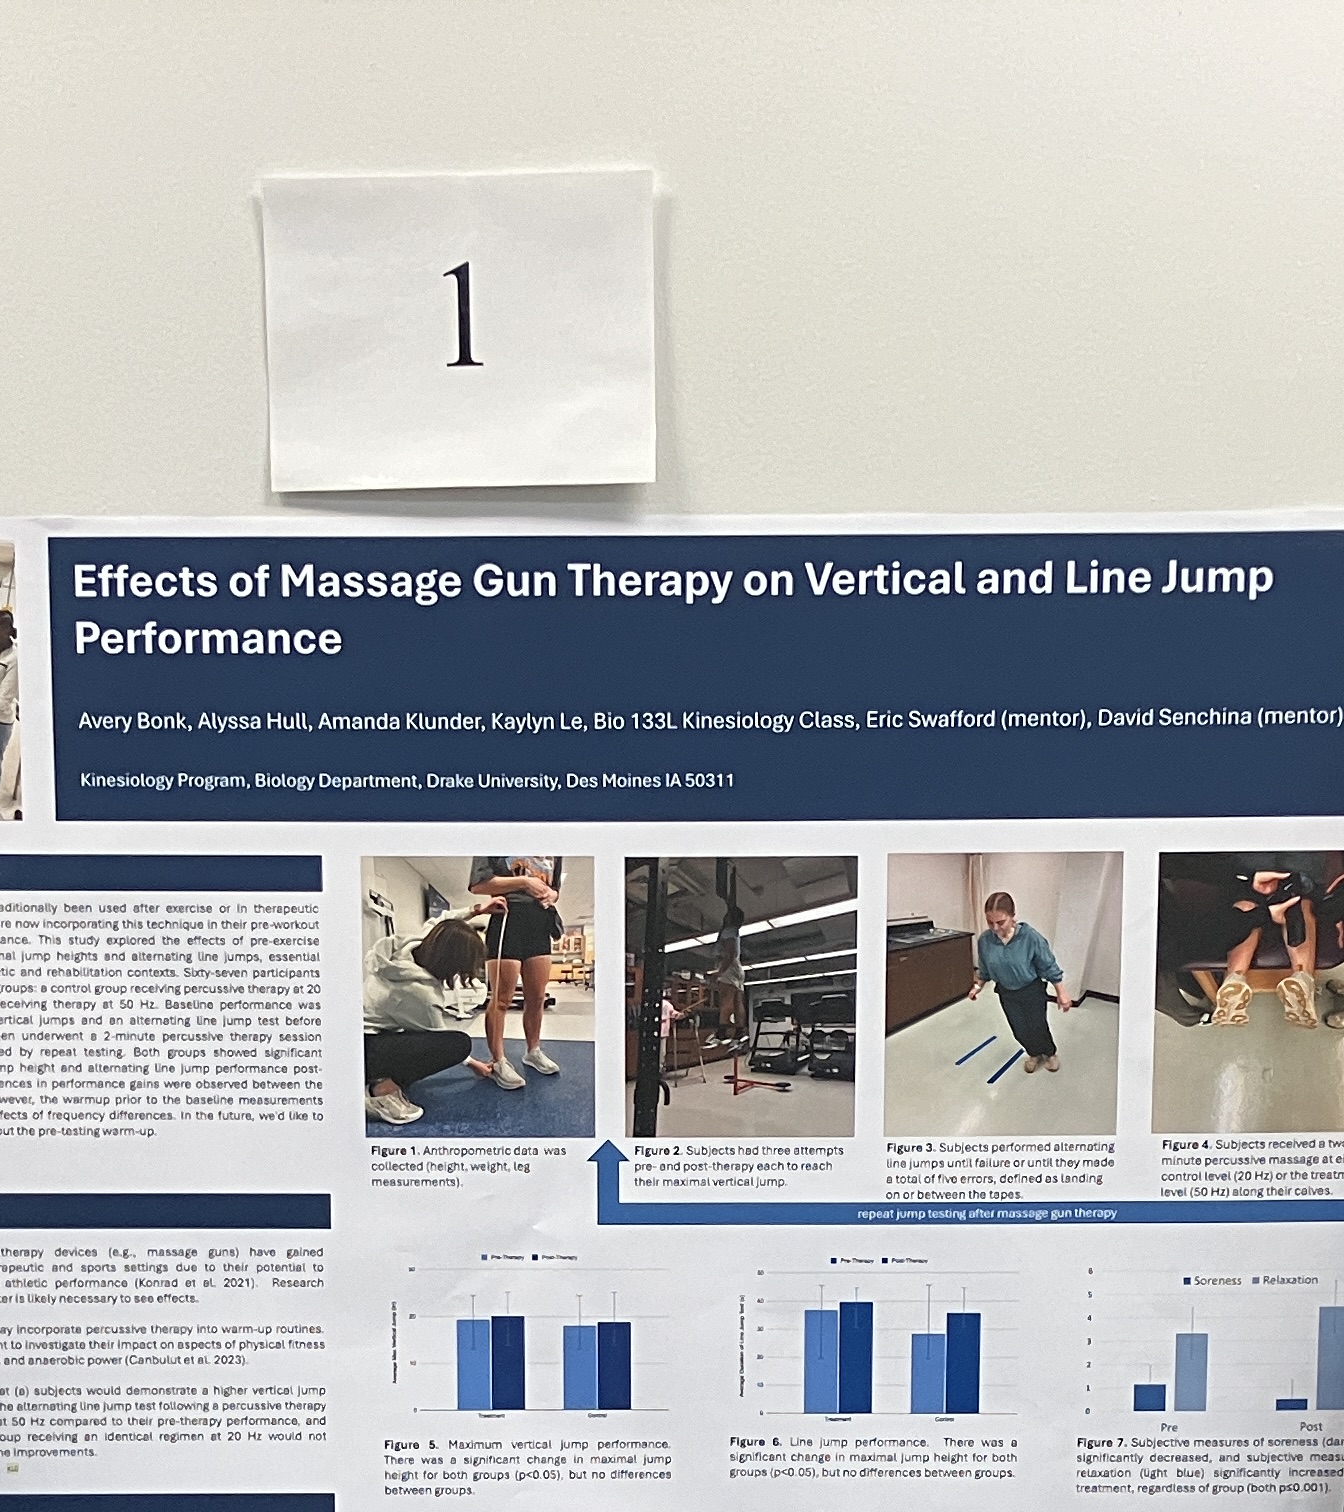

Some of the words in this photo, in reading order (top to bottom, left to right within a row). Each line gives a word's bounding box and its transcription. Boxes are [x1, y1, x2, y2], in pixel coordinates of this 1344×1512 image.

[443, 261, 484, 367] 1
[74, 563, 217, 598] Effects
[229, 563, 270, 597] of
[281, 563, 461, 606] Massage
[473, 562, 556, 597] Gun
[566, 562, 733, 604] Therapy
[743, 570, 793, 596] on
[804, 560, 966, 595] Vertical
[976, 560, 1053, 594] and
[1066, 559, 1151, 594] Line
[1161, 559, 1273, 600] Jump
[75, 620, 342, 655] Performance
[78, 711, 132, 733] Avery
[137, 711, 192, 732] Bonk,
[197, 711, 261, 733] Alyssa
[266, 711, 313, 732] Hull,
[317, 712, 400, 730] Amanda
[406, 712, 485, 732] Klunder,
[491, 712, 554, 734] Kaylyn
[560, 711, 587, 732] Le,
[594, 711, 625, 729] Bio
[631, 711, 678, 729] 133L
[682, 710, 794, 733] Kinesiology
[798, 710, 860, 731] Class,
[866, 709, 903, 728] Eric
[908, 709, 995, 727] Swafford
[1001, 708, 1092, 730] (mentor),
[1098, 707, 1154, 726] David
[1158, 706, 1252, 726] Senchina
[1257, 705, 1343, 728] (mentor)
[80, 772, 174, 791] Kinesiology
[177, 772, 250, 791] Program,
[254, 772, 315, 791] Biology
[318, 772, 422, 791] Department,
[426, 772, 474, 788] Drake
[478, 772, 561, 791] University,
[566, 772, 598, 788] Des
[602, 772, 661, 788] Moines
[665, 772, 682, 787] IA
[684, 772, 733, 787] 50311
[16, 1126, 35, 1136] the
[38, 1126, 100, 1138] pre-testing
[371, 1145, 407, 1158] Figure
[410, 1145, 420, 1155] 1.
[422, 1145, 511, 1157] Anthropometric
[513, 1145, 538, 1156] data
[543, 1147, 566, 1155] was
[634, 1145, 670, 1157] Figure
[685, 1145, 735, 1157] Subjects
[737, 1145, 759, 1155] had
[761, 1145, 791, 1155] three
[793, 1145, 844, 1157] attempts
[886, 1142, 923, 1155] Figure
[939, 1142, 989, 1154] Subjects
[991, 1141, 1051, 1154] performed
[1053, 1141, 1115, 1154] alternating
[1162, 1139, 1199, 1152] Figure
[1215, 1139, 1265, 1151] Subjects
[1267, 1138, 1316, 1149] received
[1318, 1140, 1325, 1148] a
[371, 1161, 423, 1171] collected
[513, 1161, 530, 1174] leg
[634, 1163, 657, 1173] pre-
[659, 1161, 680, 1171] and
[683, 1161, 754, 1173] post-therapy
[756, 1161, 784, 1171] each
[786, 1161, 798, 1171] to
[800, 1160, 832, 1171] reach
[634, 1176, 660, 1187] their
[662, 1176, 710, 1187] maximal
[711, 1176, 754, 1186] vertical
[857, 1209, 894, 1221] repeat
[895, 1207, 926, 1221] jump
[927, 1208, 966, 1221] testing
[968, 1208, 995, 1218] after
[996, 1209, 1048, 1220] massage
[1050, 1209, 1072, 1221] gun
[1074, 1207, 1117, 1221] therapy
[1194, 1275, 1242, 1285] Soreness
[1262, 1274, 1318, 1285] Relaxation
[1160, 1422, 1178, 1432] Pre
[1299, 1421, 1323, 1432] Post
